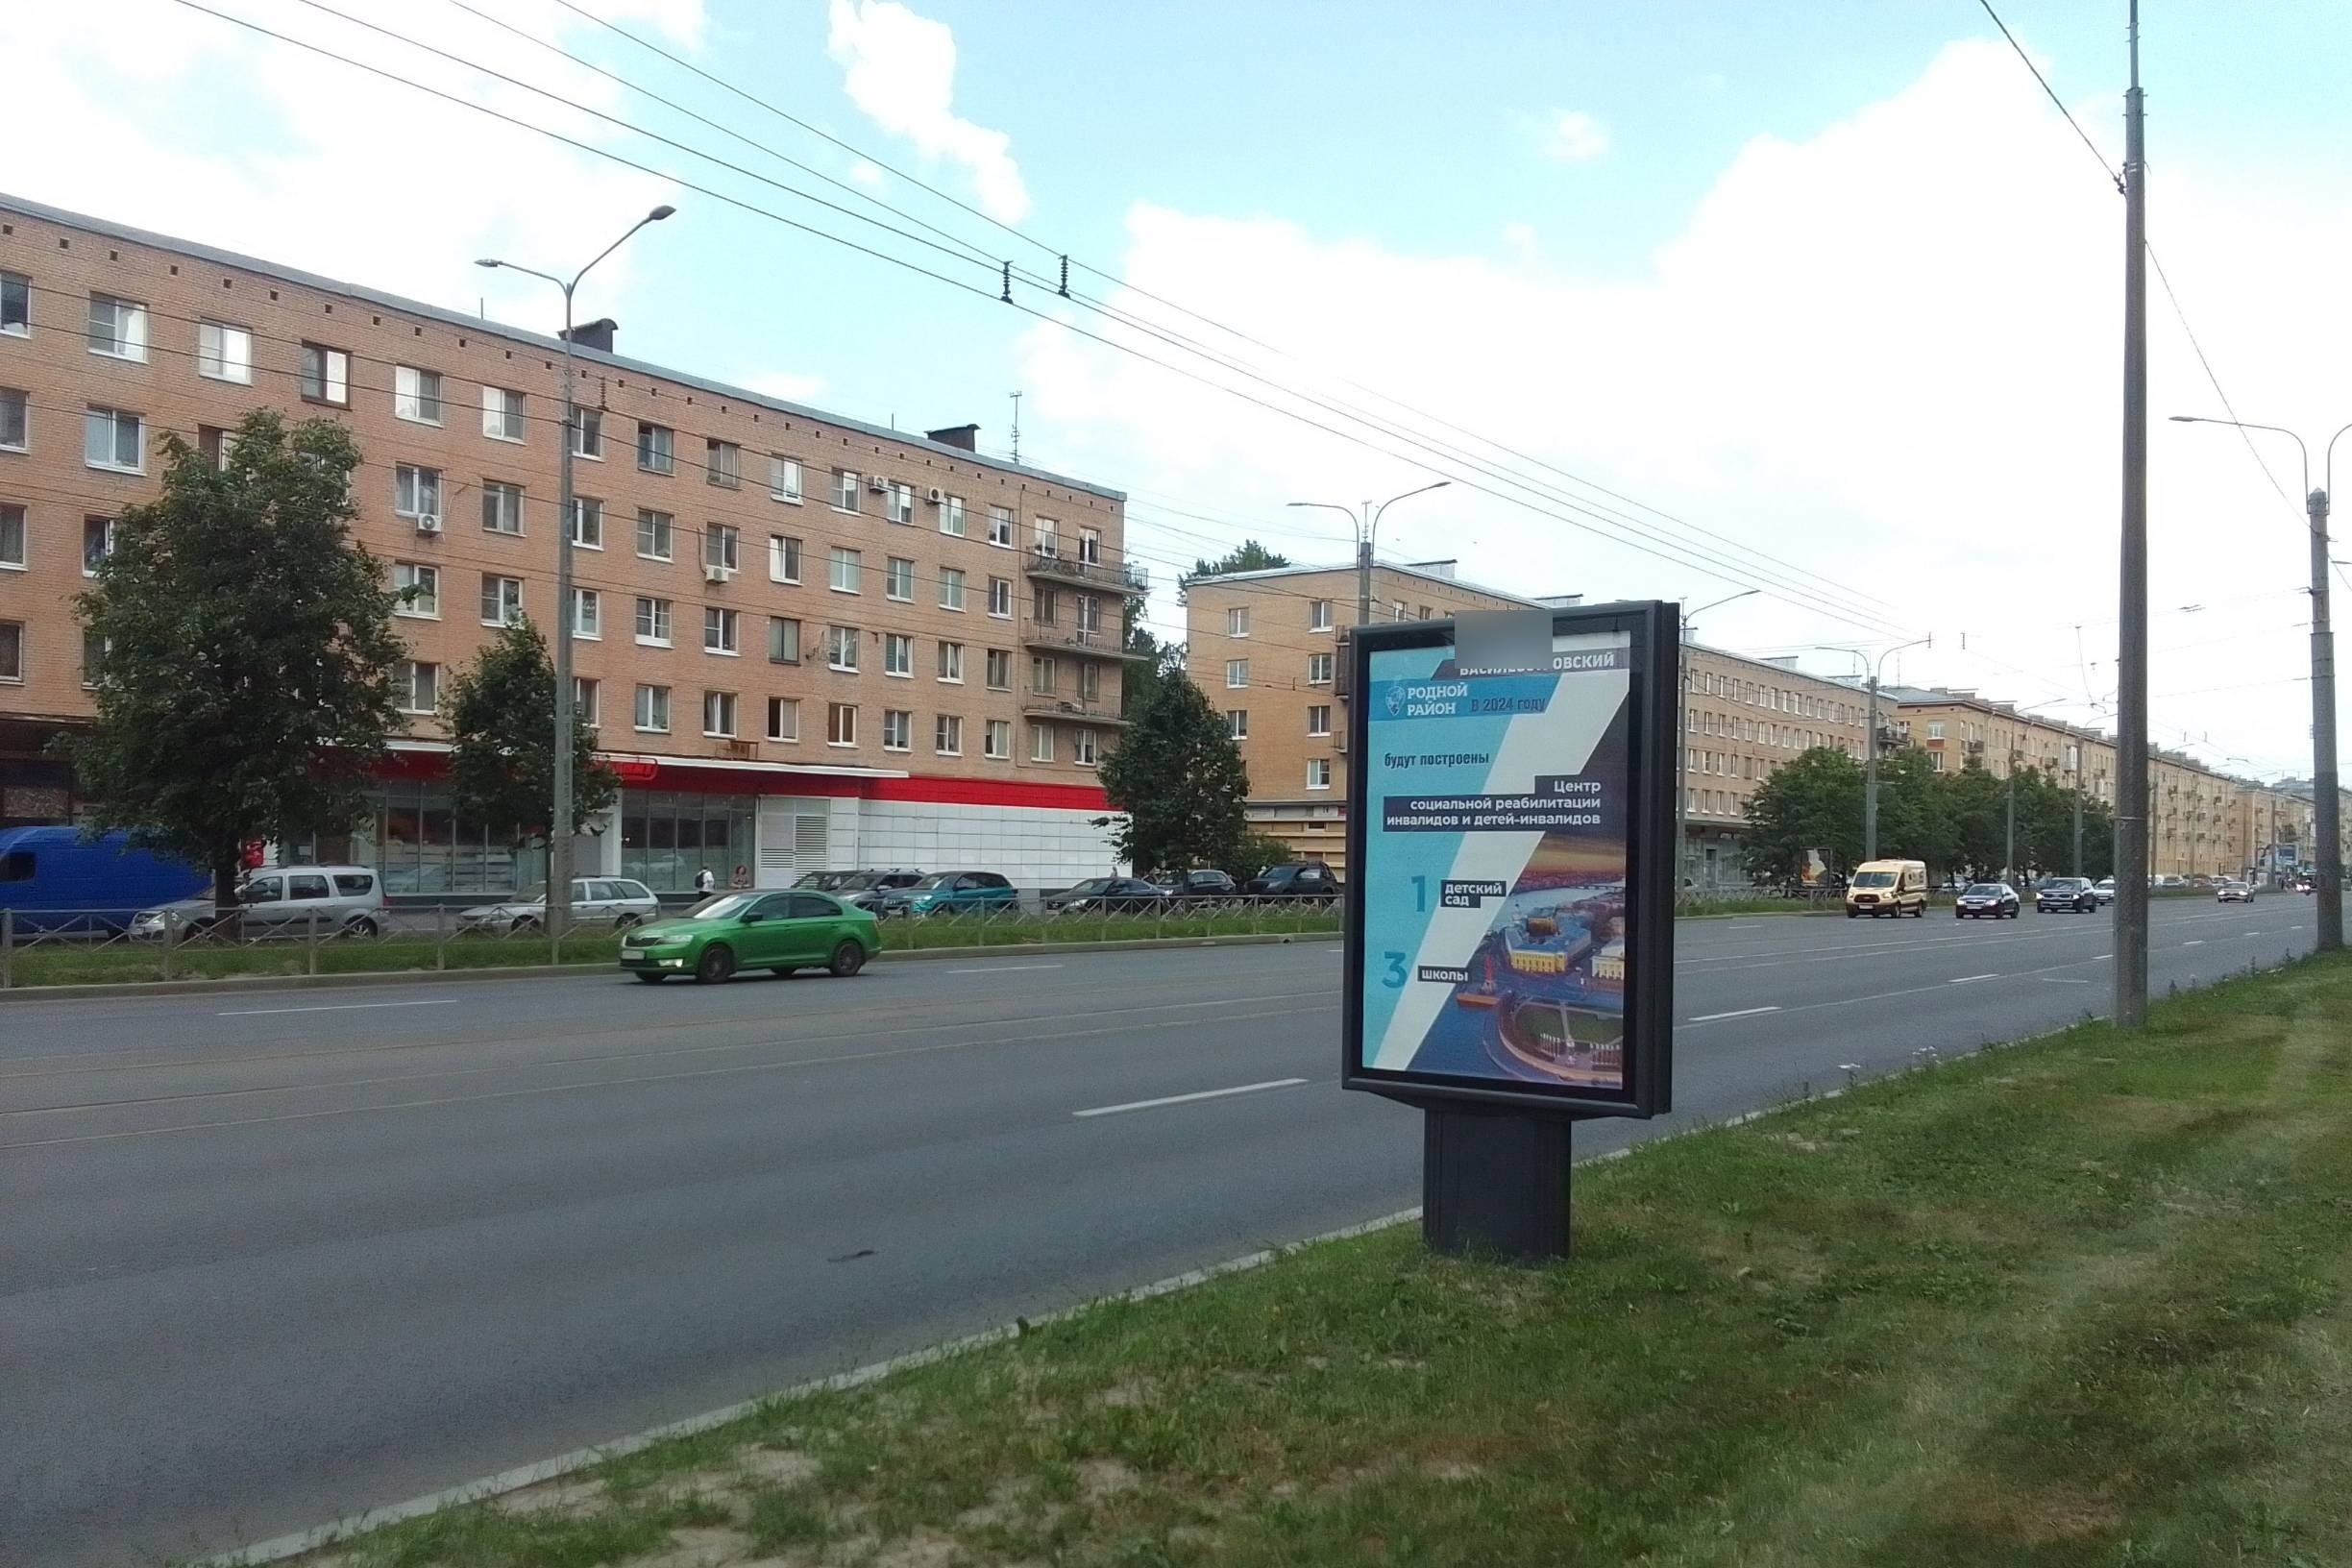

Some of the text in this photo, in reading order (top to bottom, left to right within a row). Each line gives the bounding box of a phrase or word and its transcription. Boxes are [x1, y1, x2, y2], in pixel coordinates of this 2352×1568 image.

[1459, 651, 1615, 676] ВАСОВСКИЙ
[1407, 682, 1468, 699] РОДНОЙ
[1407, 701, 1456, 717] РАЙОН
[1483, 698, 1513, 711] 2024
[1517, 698, 1546, 713] году
[1384, 752, 1489, 769] будут построены
[1554, 780, 1602, 795] Центр
[1410, 796, 1601, 812] социальной реабилитации
[1386, 814, 1601, 827] инвалидов и детей-инвалидов
[1410, 874, 1426, 913] 1
[1445, 882, 1503, 895] детский
[1445, 895, 1470, 907] сад
[1382, 950, 1409, 989] 3
[1421, 968, 1469, 982] школы
